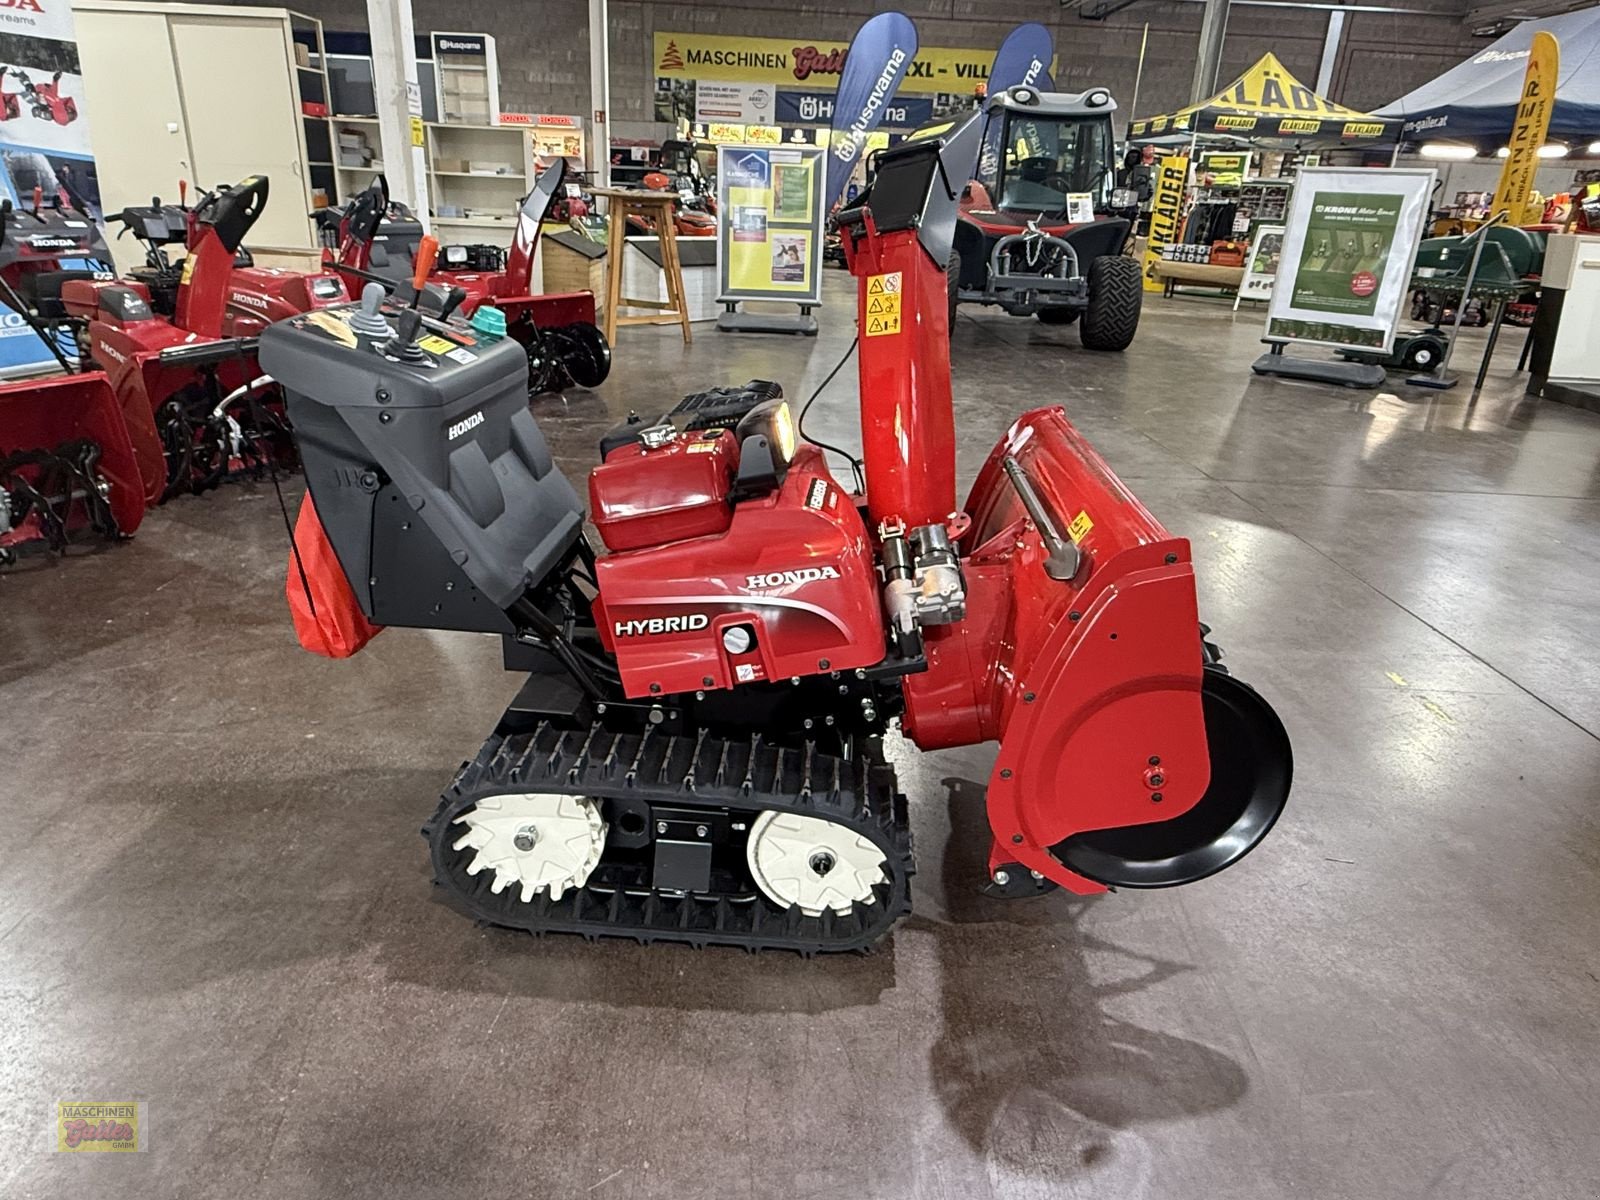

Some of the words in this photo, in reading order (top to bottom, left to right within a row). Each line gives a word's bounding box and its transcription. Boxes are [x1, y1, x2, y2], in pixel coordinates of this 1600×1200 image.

[447, 41, 481, 50] Husqvarna
[687, 49, 787, 69] MASCHINEN
[847, 48, 906, 145] Husqvarna
[1324, 206, 1358, 214] KRONE
[32, 239, 76, 247] HONDA
[233, 293, 268, 309] HONDA
[449, 411, 485, 440] HONDA
[746, 566, 840, 589] HONDA
[615, 615, 708, 636] HYBRID
